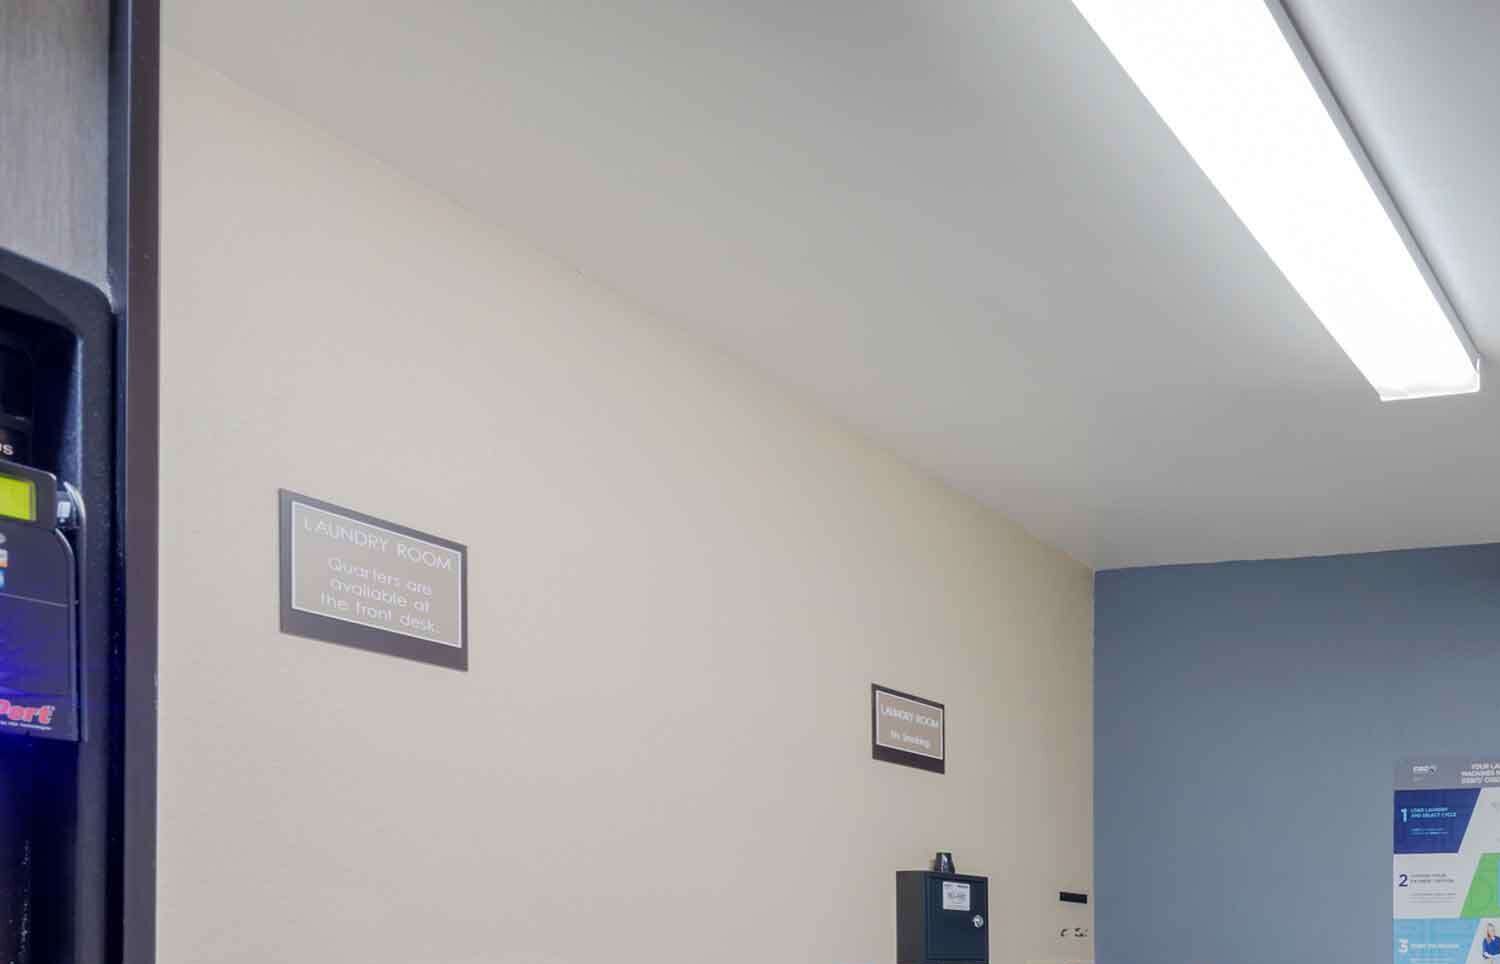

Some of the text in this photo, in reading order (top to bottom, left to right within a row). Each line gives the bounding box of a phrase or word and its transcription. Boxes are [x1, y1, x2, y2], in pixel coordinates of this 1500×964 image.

[303, 518, 451, 569] LAUNDRY ROOM
[328, 556, 433, 595] Quarters are
[321, 591, 349, 610] the
[356, 600, 392, 621] front
[330, 578, 430, 613] available at
[1400, 808, 1408, 823] 1
[1398, 874, 1408, 887] 2
